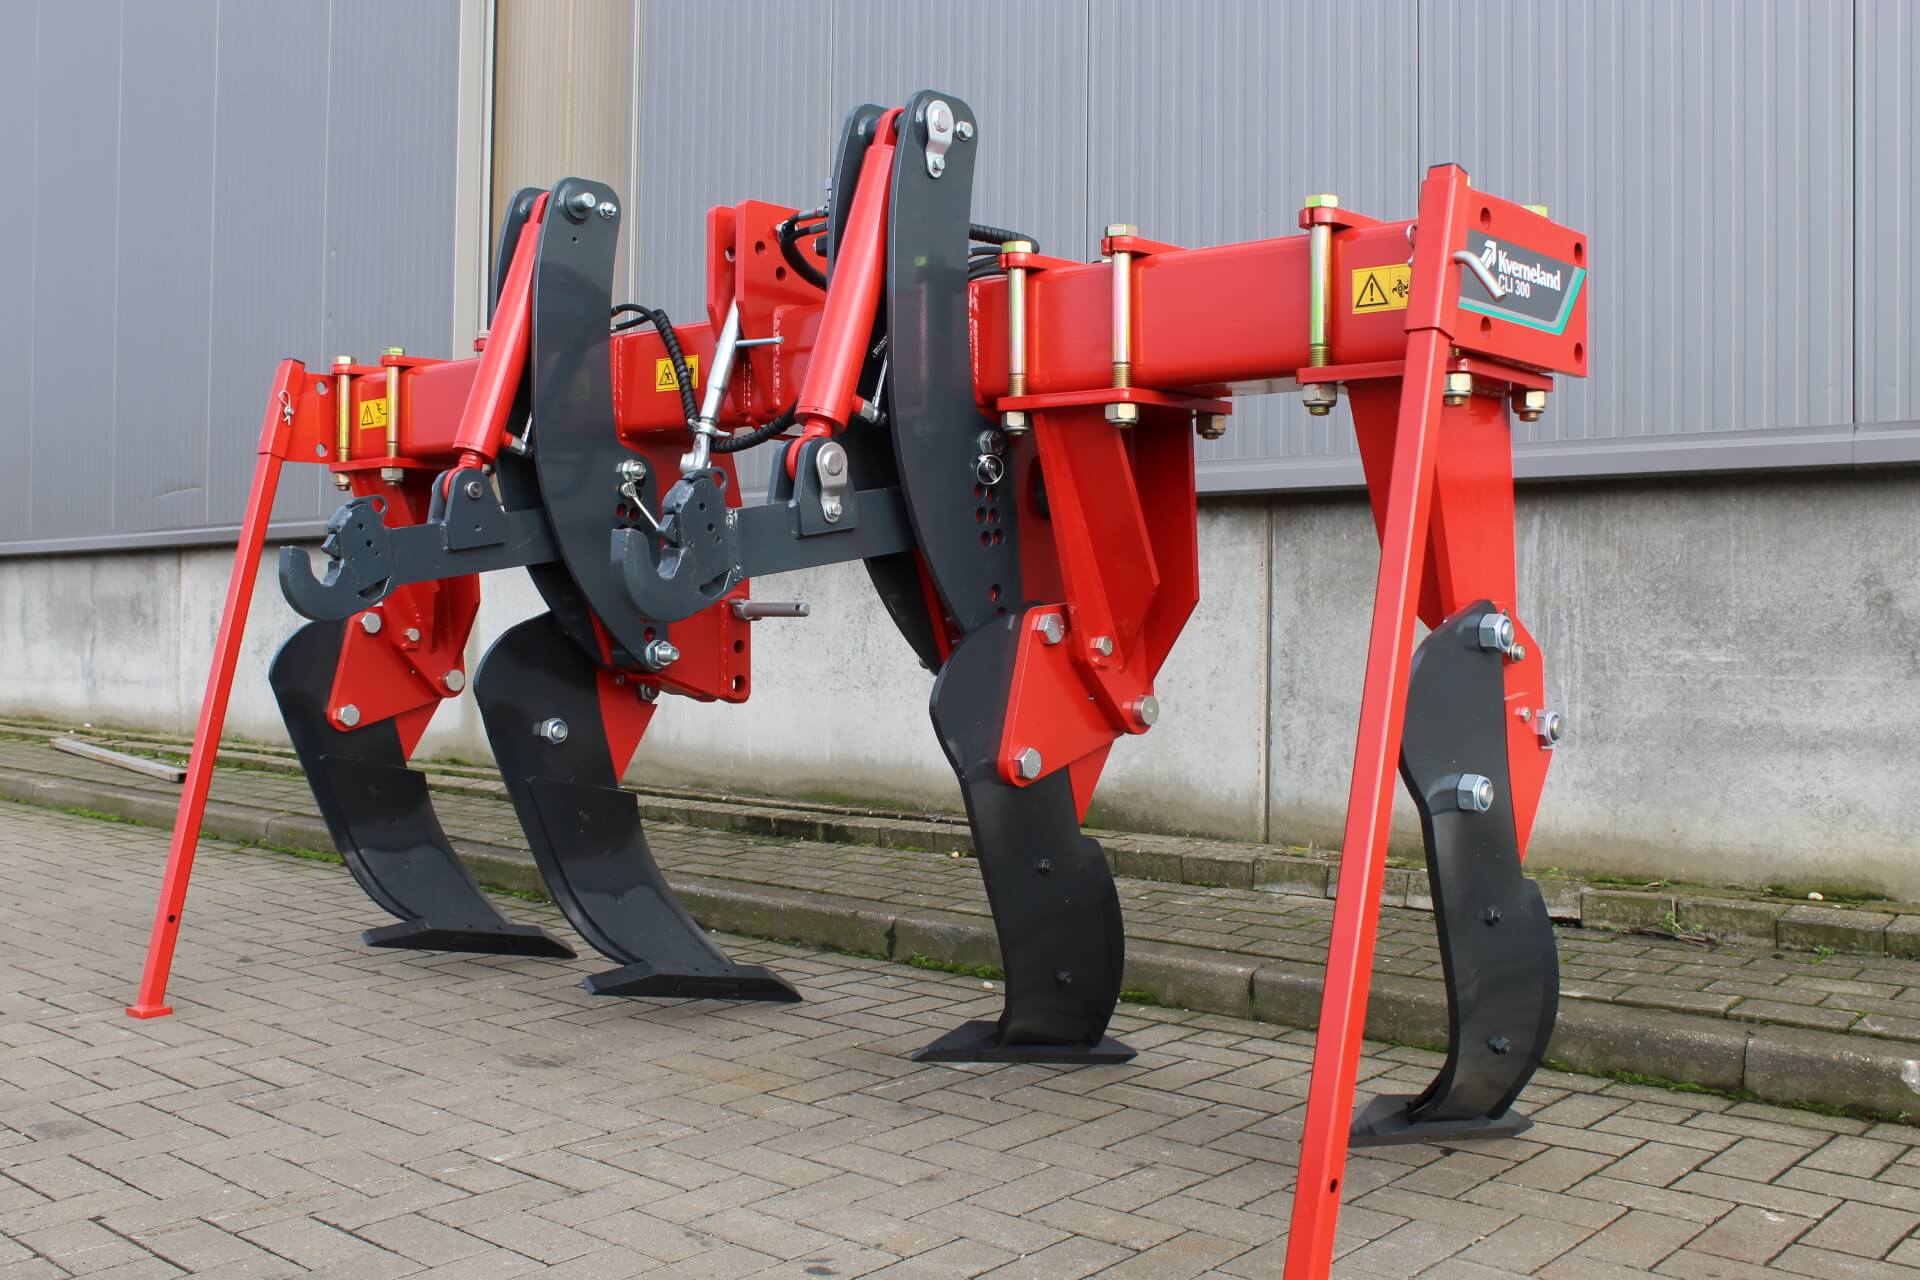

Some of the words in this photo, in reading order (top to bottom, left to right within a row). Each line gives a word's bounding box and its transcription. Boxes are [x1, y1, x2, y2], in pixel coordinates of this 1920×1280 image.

[1498, 250, 1560, 291] Kverneland
[1498, 274, 1513, 293] CLI
[1515, 280, 1530, 298] 300
